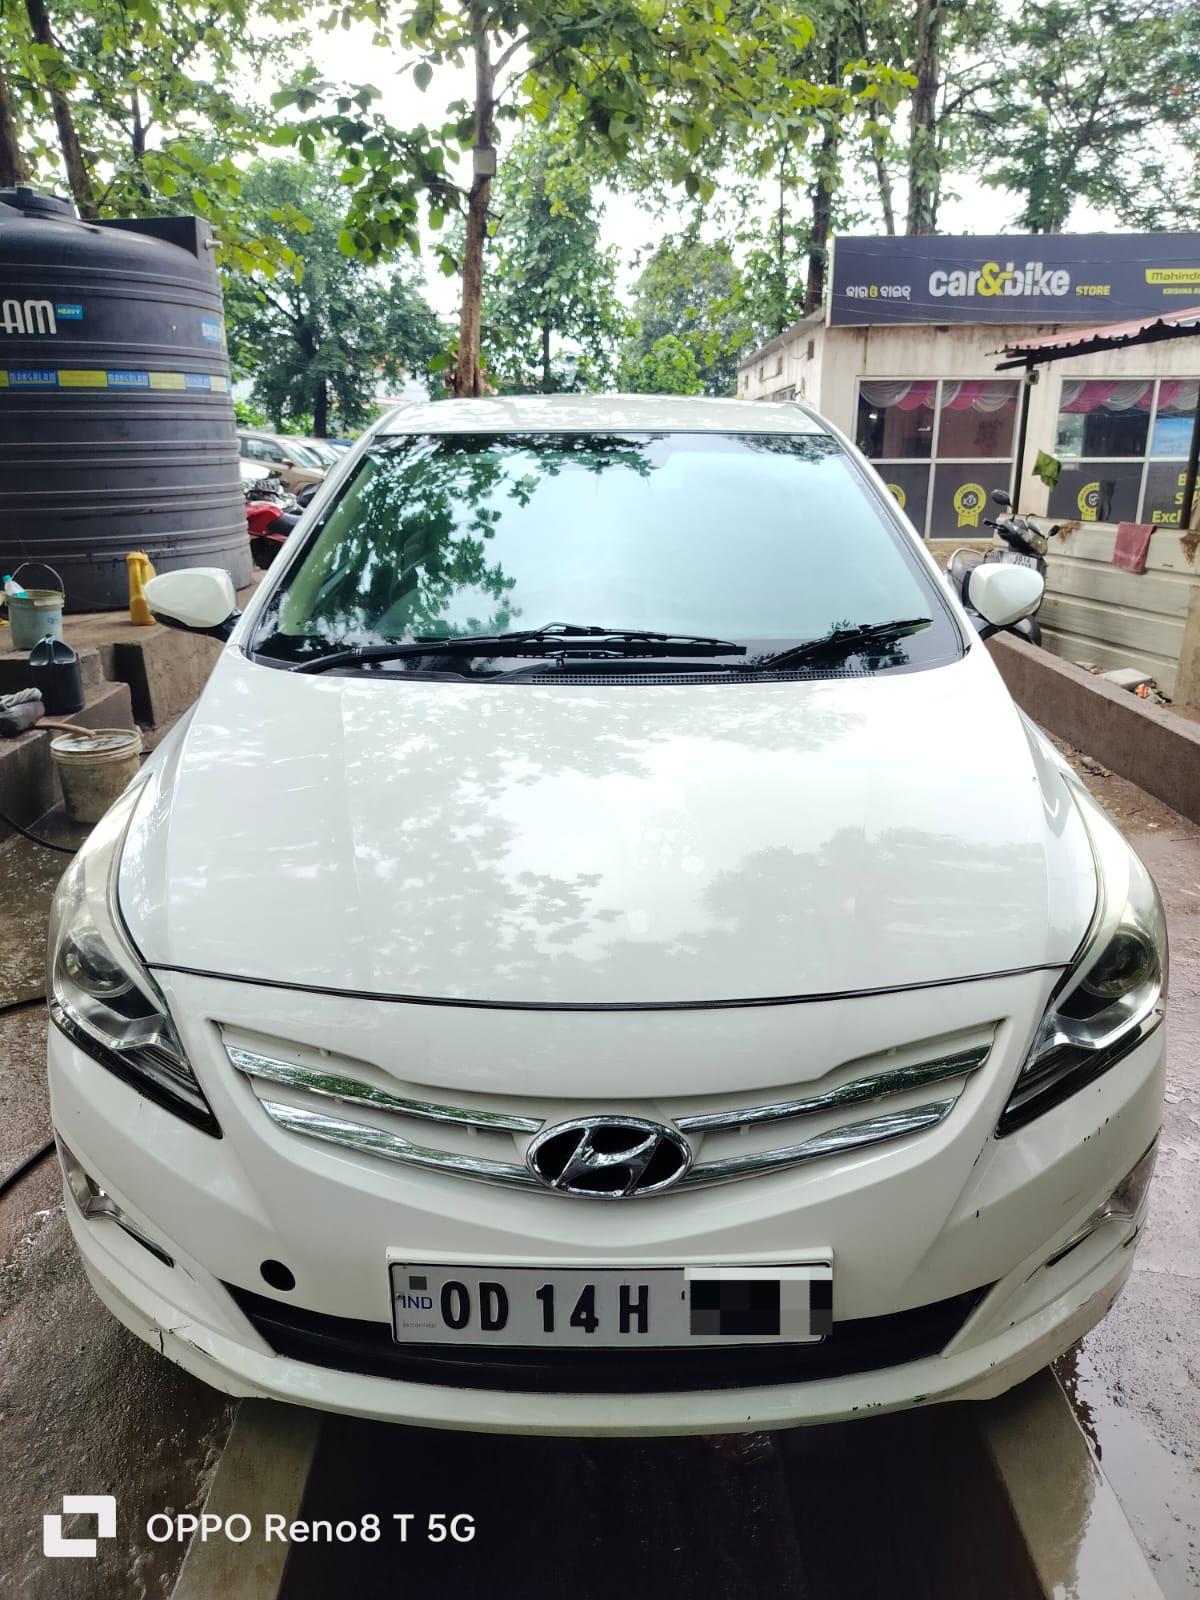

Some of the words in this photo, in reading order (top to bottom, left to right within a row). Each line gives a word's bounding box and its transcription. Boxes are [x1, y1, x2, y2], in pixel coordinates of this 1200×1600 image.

[928, 261, 1071, 297] car&bike
[1075, 285, 1111, 296] STORE
[0, 299, 57, 334] AM
[402, 1294, 433, 1310] IND
[440, 1280, 509, 1332] OD
[535, 1284, 600, 1333] 14
[619, 1284, 649, 1334] H
